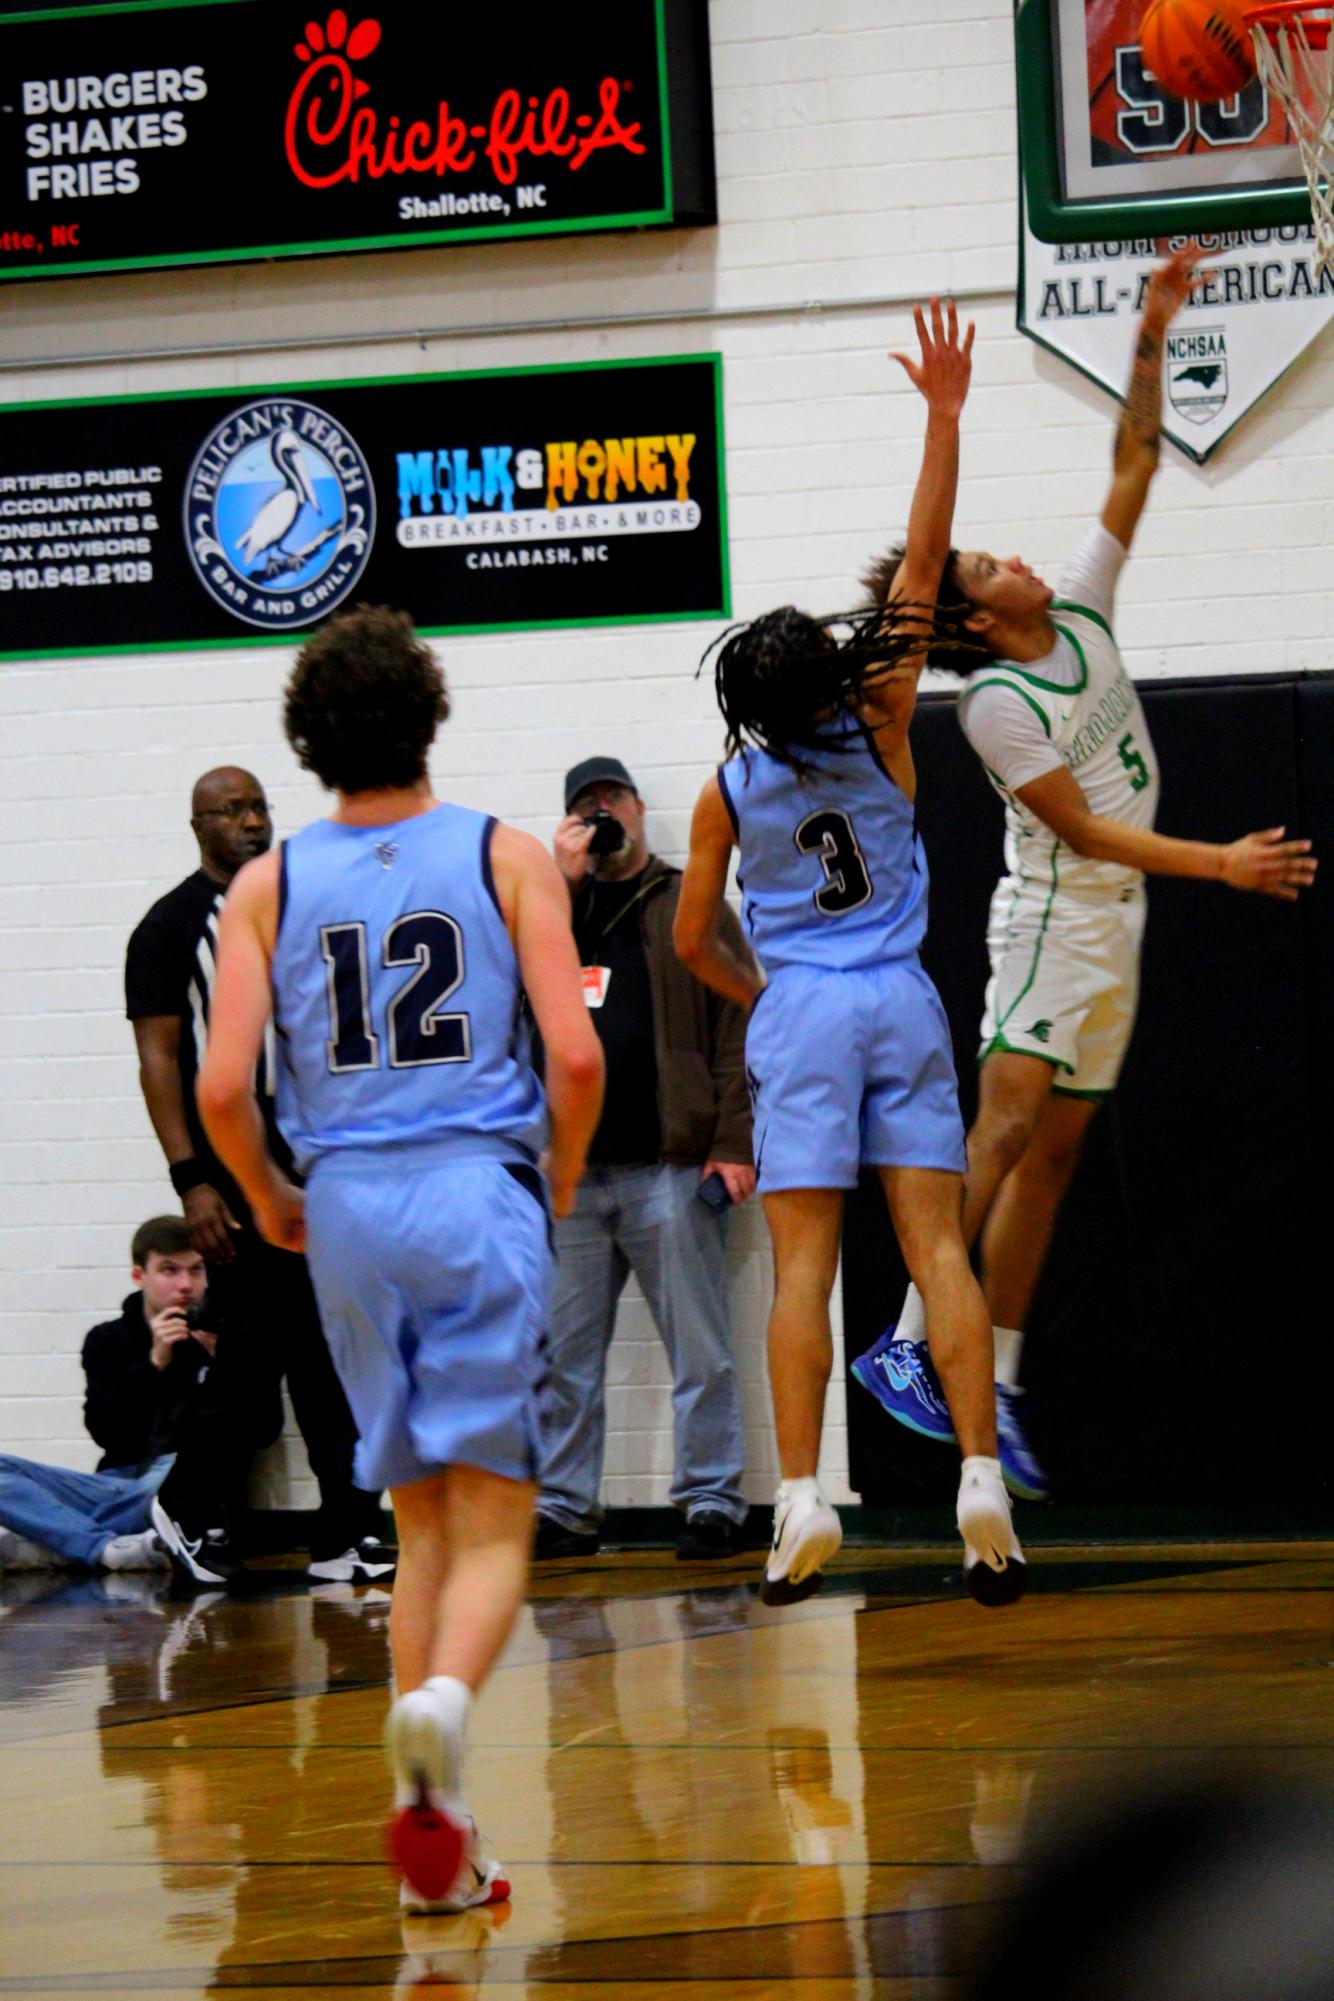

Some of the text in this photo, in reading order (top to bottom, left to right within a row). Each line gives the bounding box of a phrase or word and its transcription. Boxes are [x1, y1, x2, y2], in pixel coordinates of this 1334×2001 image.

[23, 66, 207, 115] BURGERS
[25, 111, 187, 158] SHAKES
[285, 54, 646, 188] Chick-fil-A
[27, 158, 140, 201] FRIES
[399, 185, 547, 219] Shallotte, NC
[0, 223, 80, 255] tte, NC
[1167, 333, 1226, 360] NCHSAA
[192, 405, 364, 501] PELICAN'S PERCH
[0, 466, 162, 492] RTIFIED PUBLIC
[0, 491, 152, 516] CCOUNTANTS
[141, 514, 159, 531] &
[403, 506, 697, 541] BREAKFAST BAR & MORE
[0, 537, 151, 562] AX ADVISORS
[466, 545, 609, 570] CALABASH, NC
[0, 560, 153, 591] 910.642.2109
[211, 560, 353, 615] BAR AND GRILL
[1117, 730, 1149, 793] 5
[794, 806, 873, 918] 3
[320, 909, 471, 1074] 12
